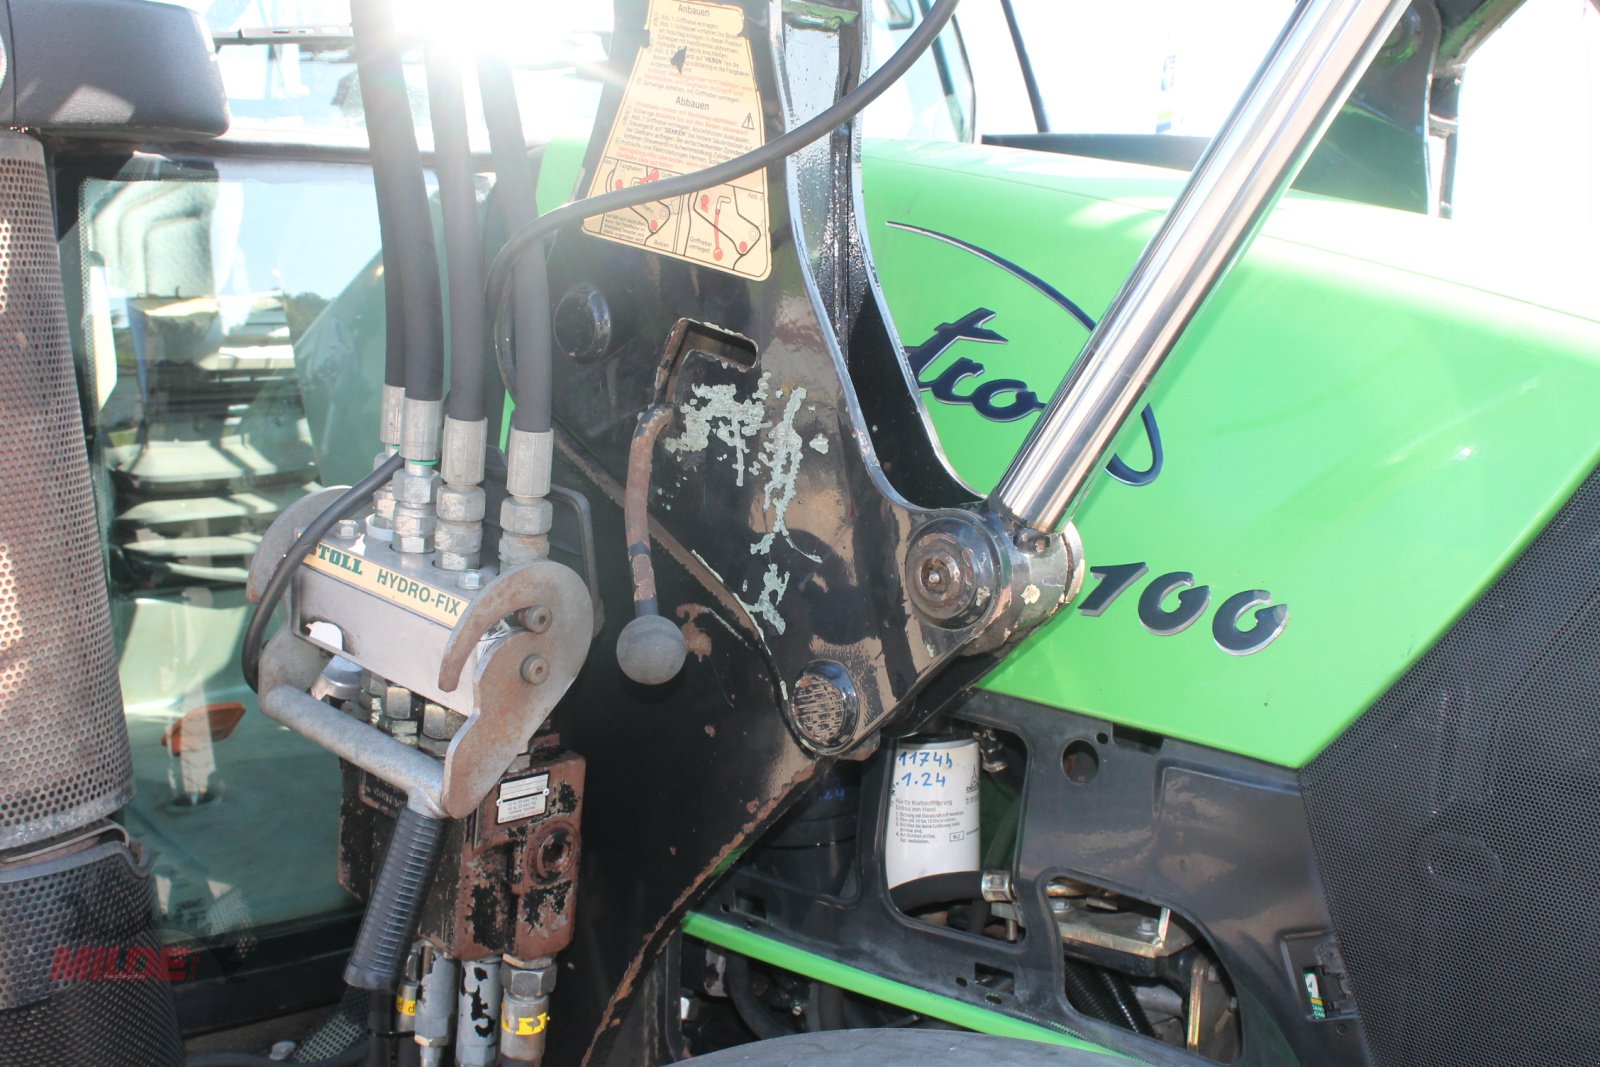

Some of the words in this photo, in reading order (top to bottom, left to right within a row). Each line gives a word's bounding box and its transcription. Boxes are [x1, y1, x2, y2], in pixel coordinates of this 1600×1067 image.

[678, 4, 710, 16] Anbauen
[676, 96, 710, 111] Abbauen
[309, 543, 363, 576] TOLL
[376, 568, 461, 616] HYDRO-FIX
[1077, 561, 1289, 657] 100
